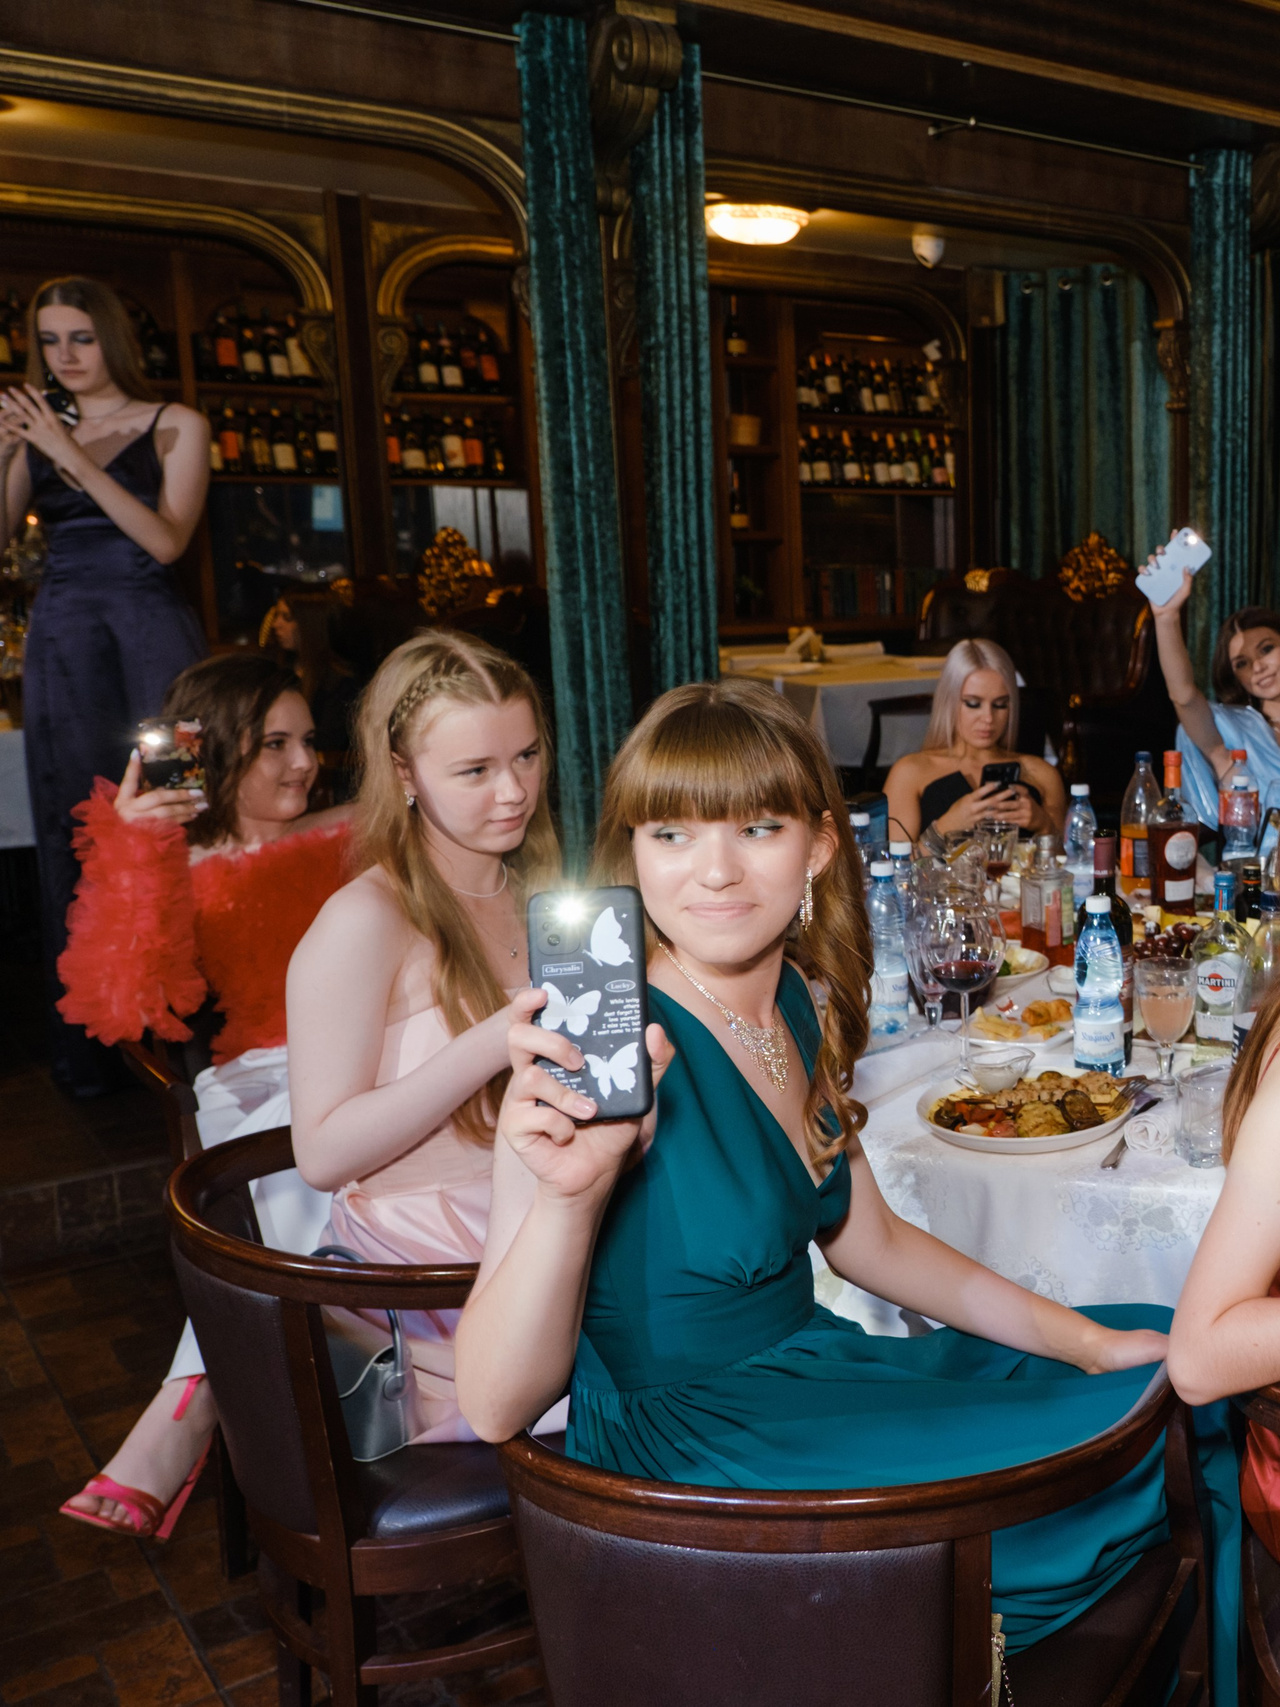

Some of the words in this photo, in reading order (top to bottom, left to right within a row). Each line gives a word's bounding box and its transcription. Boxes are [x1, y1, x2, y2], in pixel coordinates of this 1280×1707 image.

[544, 964, 581, 974] Chrysalis
[610, 982, 630, 990] Lucky
[1198, 977, 1235, 988] MARTINI
[620, 1014, 640, 1022] yourself
